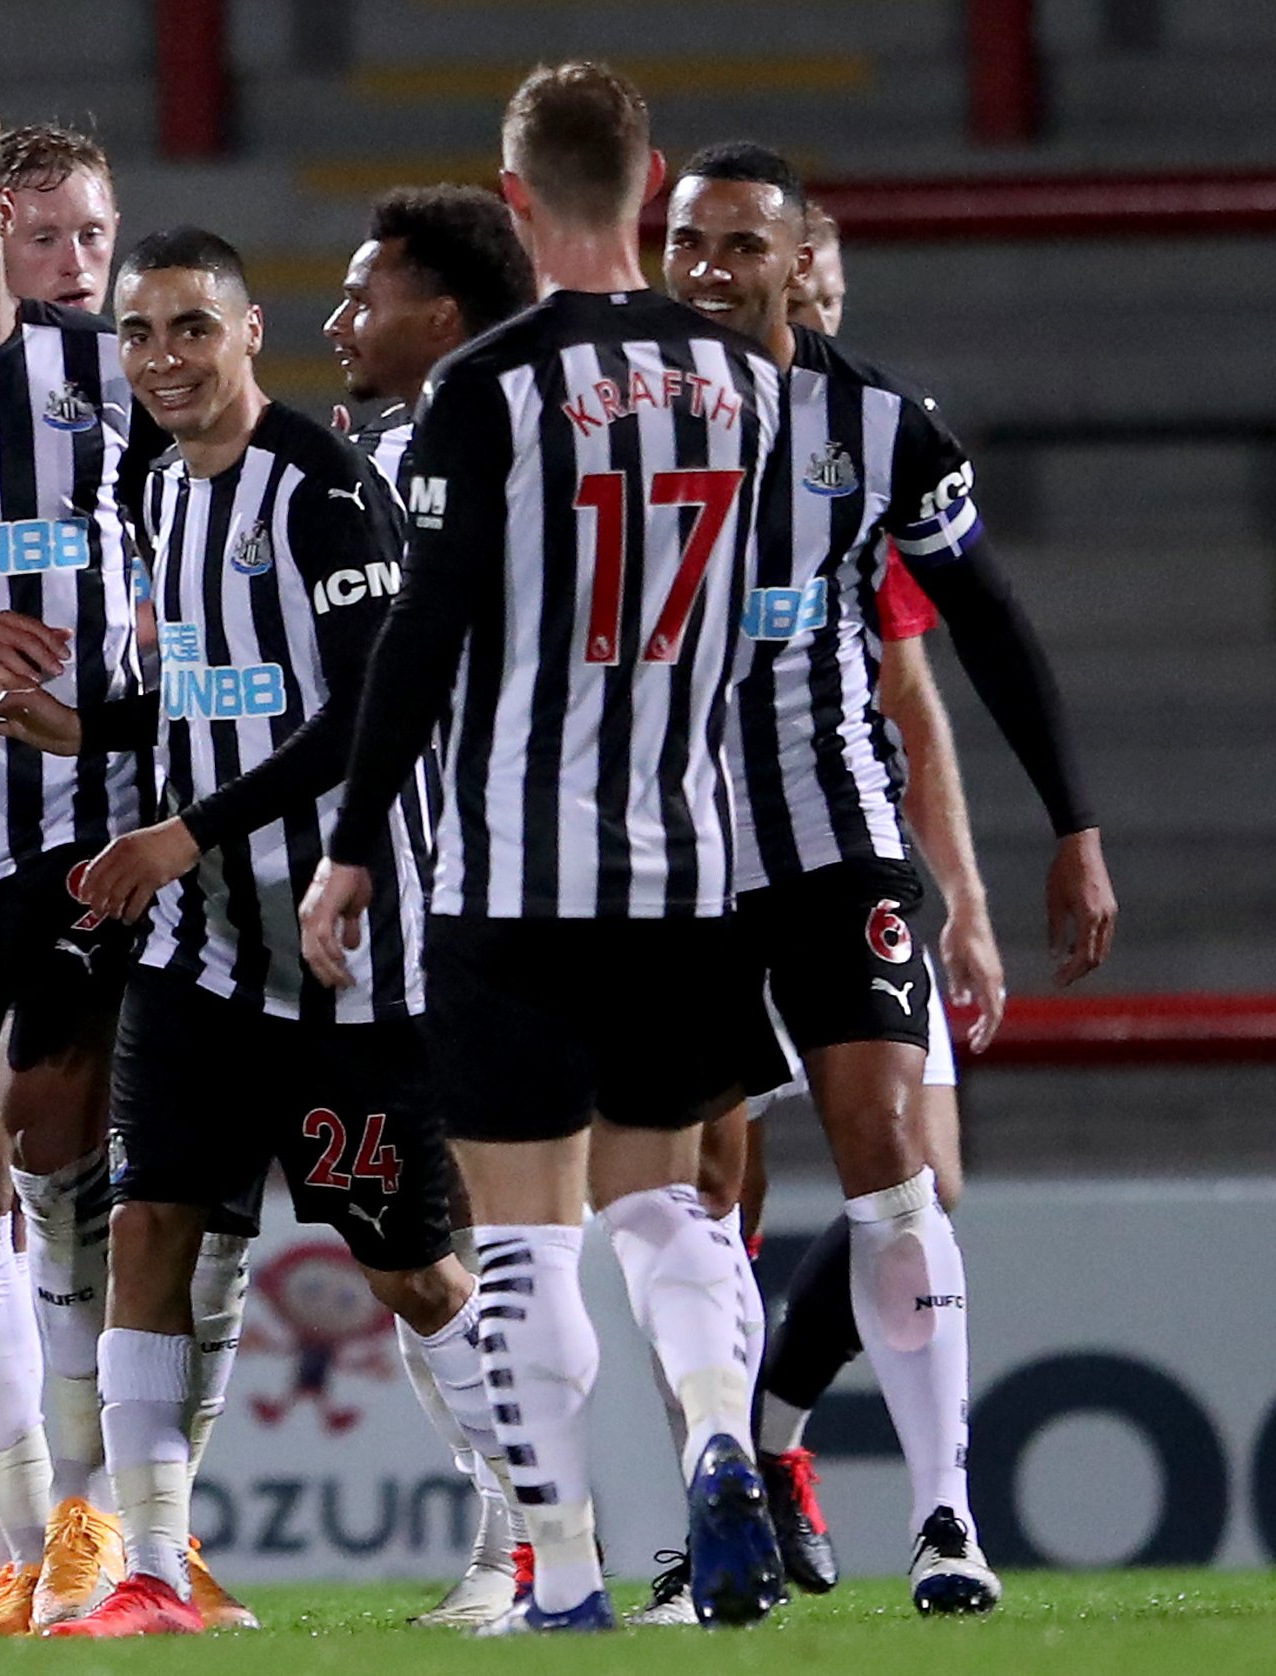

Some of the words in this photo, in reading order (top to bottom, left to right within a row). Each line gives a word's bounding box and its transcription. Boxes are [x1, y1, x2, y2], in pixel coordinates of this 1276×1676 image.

[561, 368, 742, 438] KRAFTH
[919, 460, 974, 519] IC
[572, 468, 746, 667] 17
[865, 899, 912, 964] 6
[302, 1107, 404, 1195] 24
[37, 1286, 95, 1308] NUFC
[914, 1294, 964, 1312] NUFC
